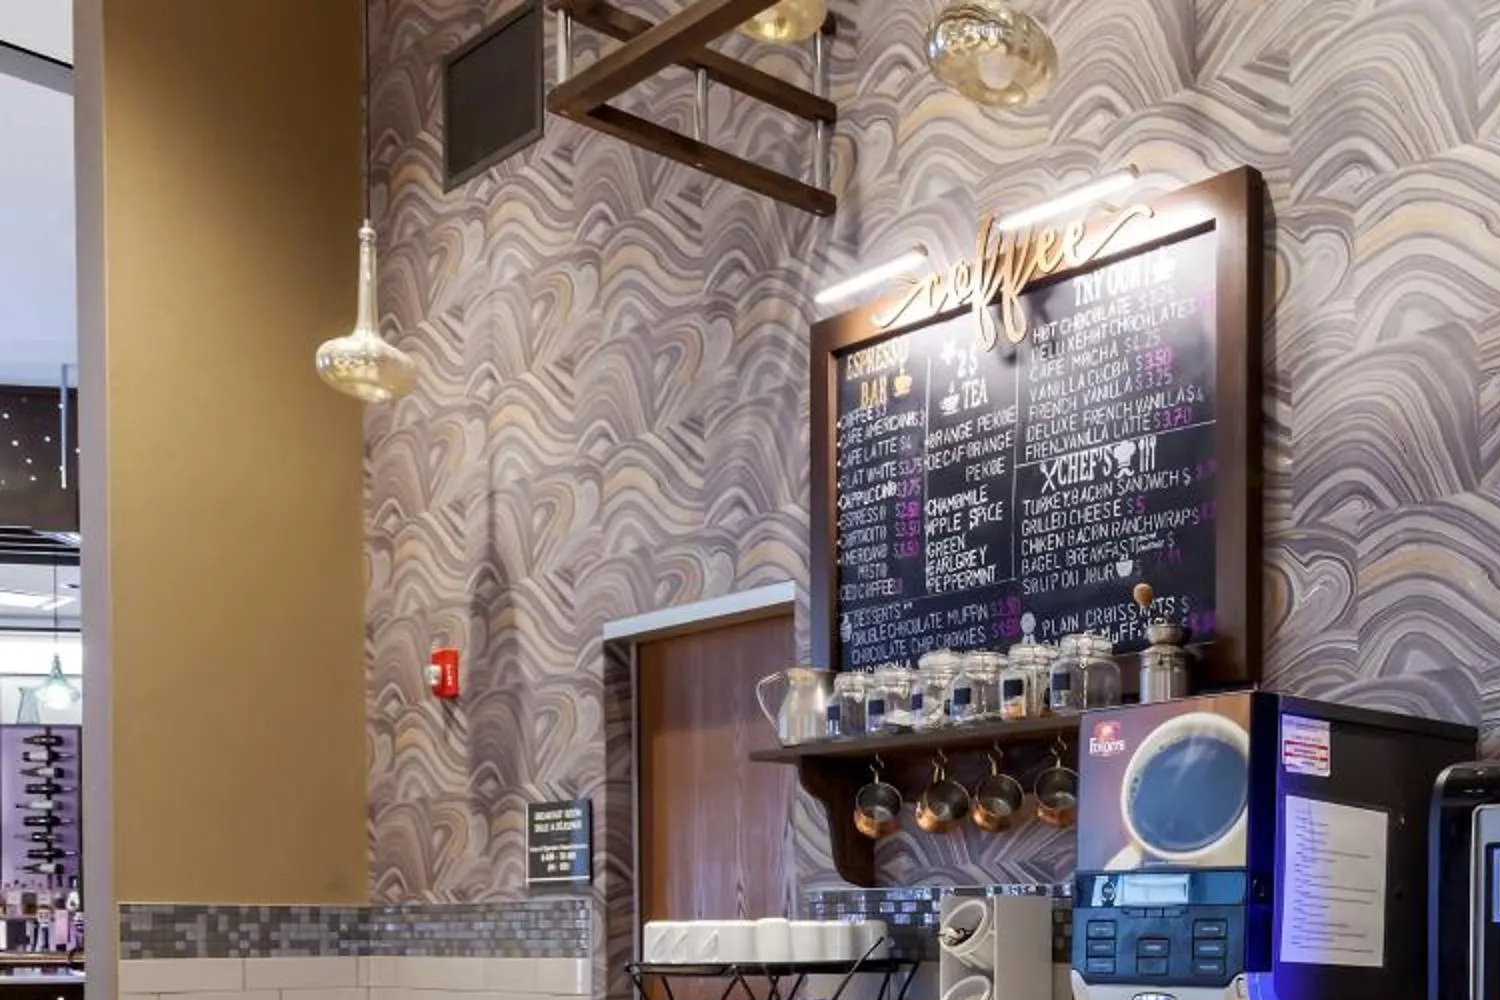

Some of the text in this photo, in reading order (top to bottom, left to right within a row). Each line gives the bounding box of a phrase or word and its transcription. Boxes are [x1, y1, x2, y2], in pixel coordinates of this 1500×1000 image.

[870, 205, 1155, 352] coffee
[962, 376, 988, 411] TEA
[1027, 413, 1078, 443] DELUXE
[1083, 400, 1132, 427] FRENCH
[1135, 386, 1186, 412] VANILLA
[1114, 415, 1151, 438] LATTE
[1058, 445, 1113, 486] CHEF'S
[1070, 499, 1122, 526] CHEESE
[1021, 553, 1061, 576] BAGEL
[1042, 613, 1080, 636] PLAIN
